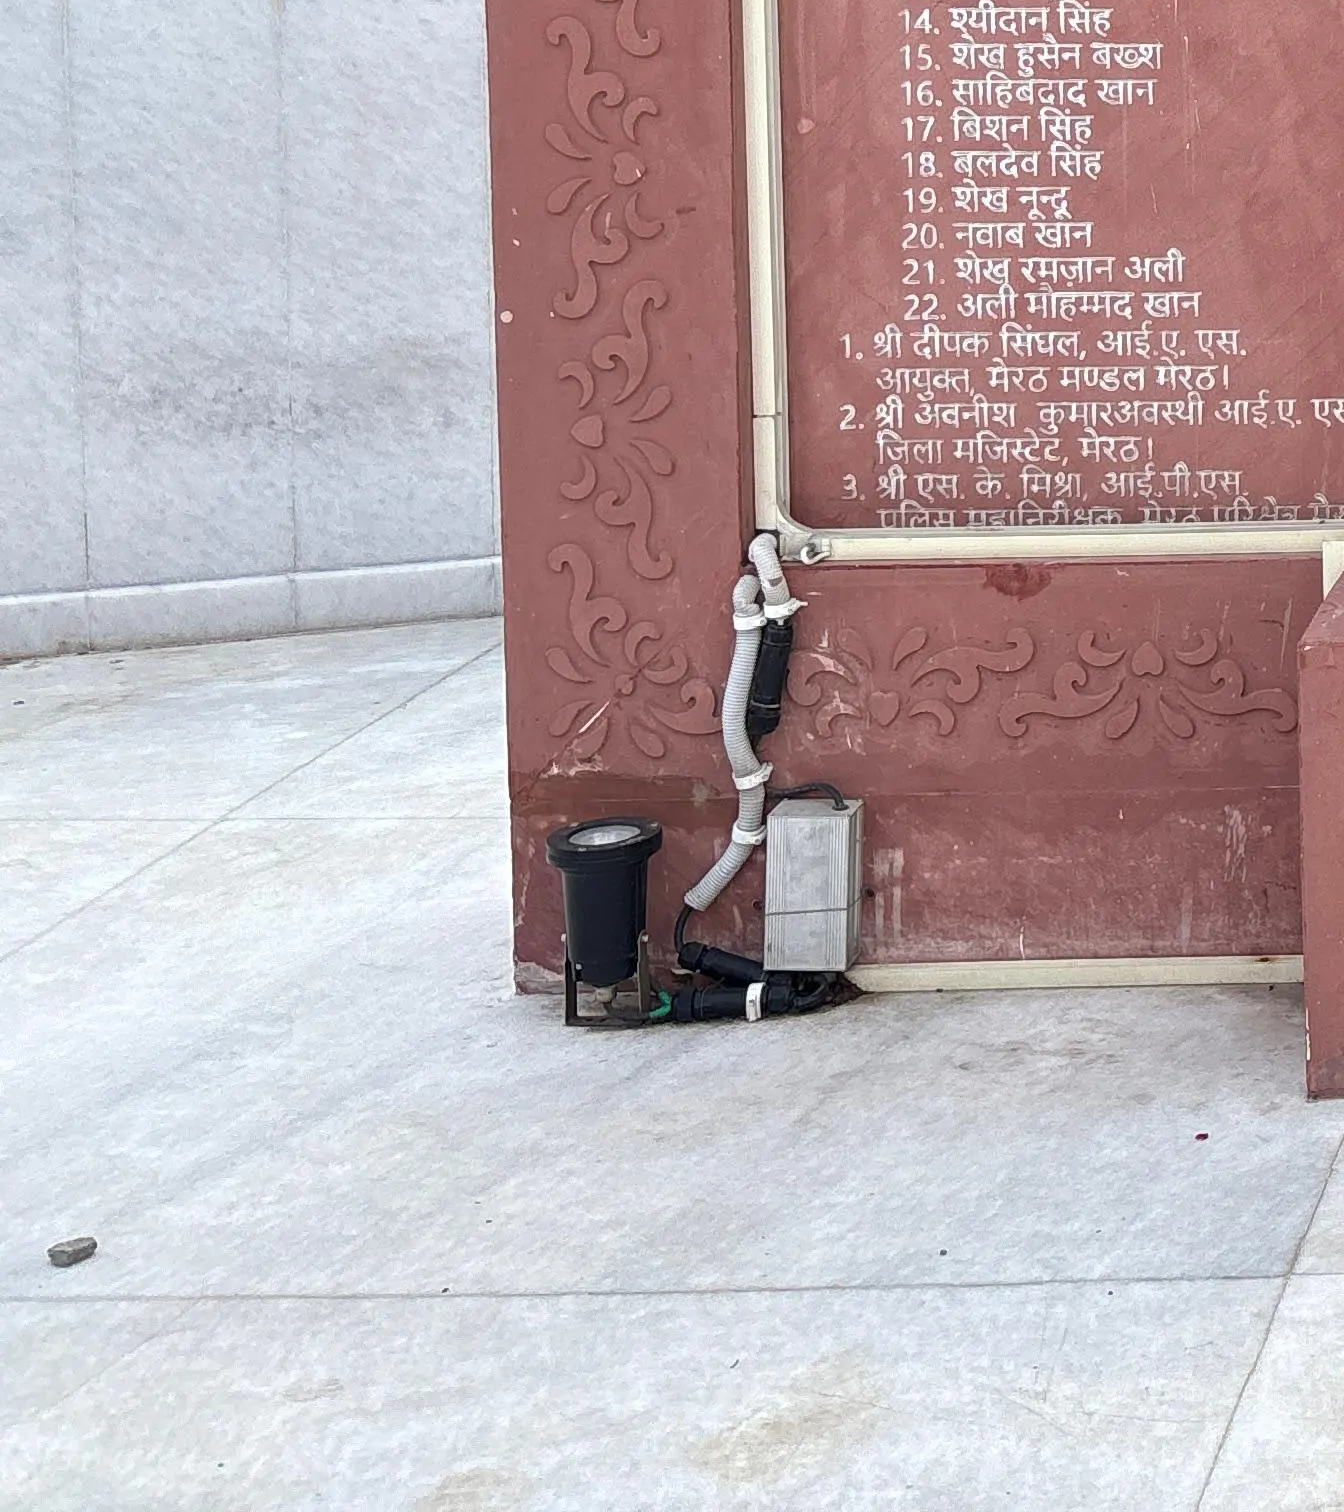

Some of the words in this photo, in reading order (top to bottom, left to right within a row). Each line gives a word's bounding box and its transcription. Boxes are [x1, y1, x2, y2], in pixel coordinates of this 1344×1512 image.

[840, 334, 863, 359] 1.
[874, 323, 903, 358] श्री
[910, 323, 992, 359] दीपक
[1058, 367, 1146, 391] मण्डल
